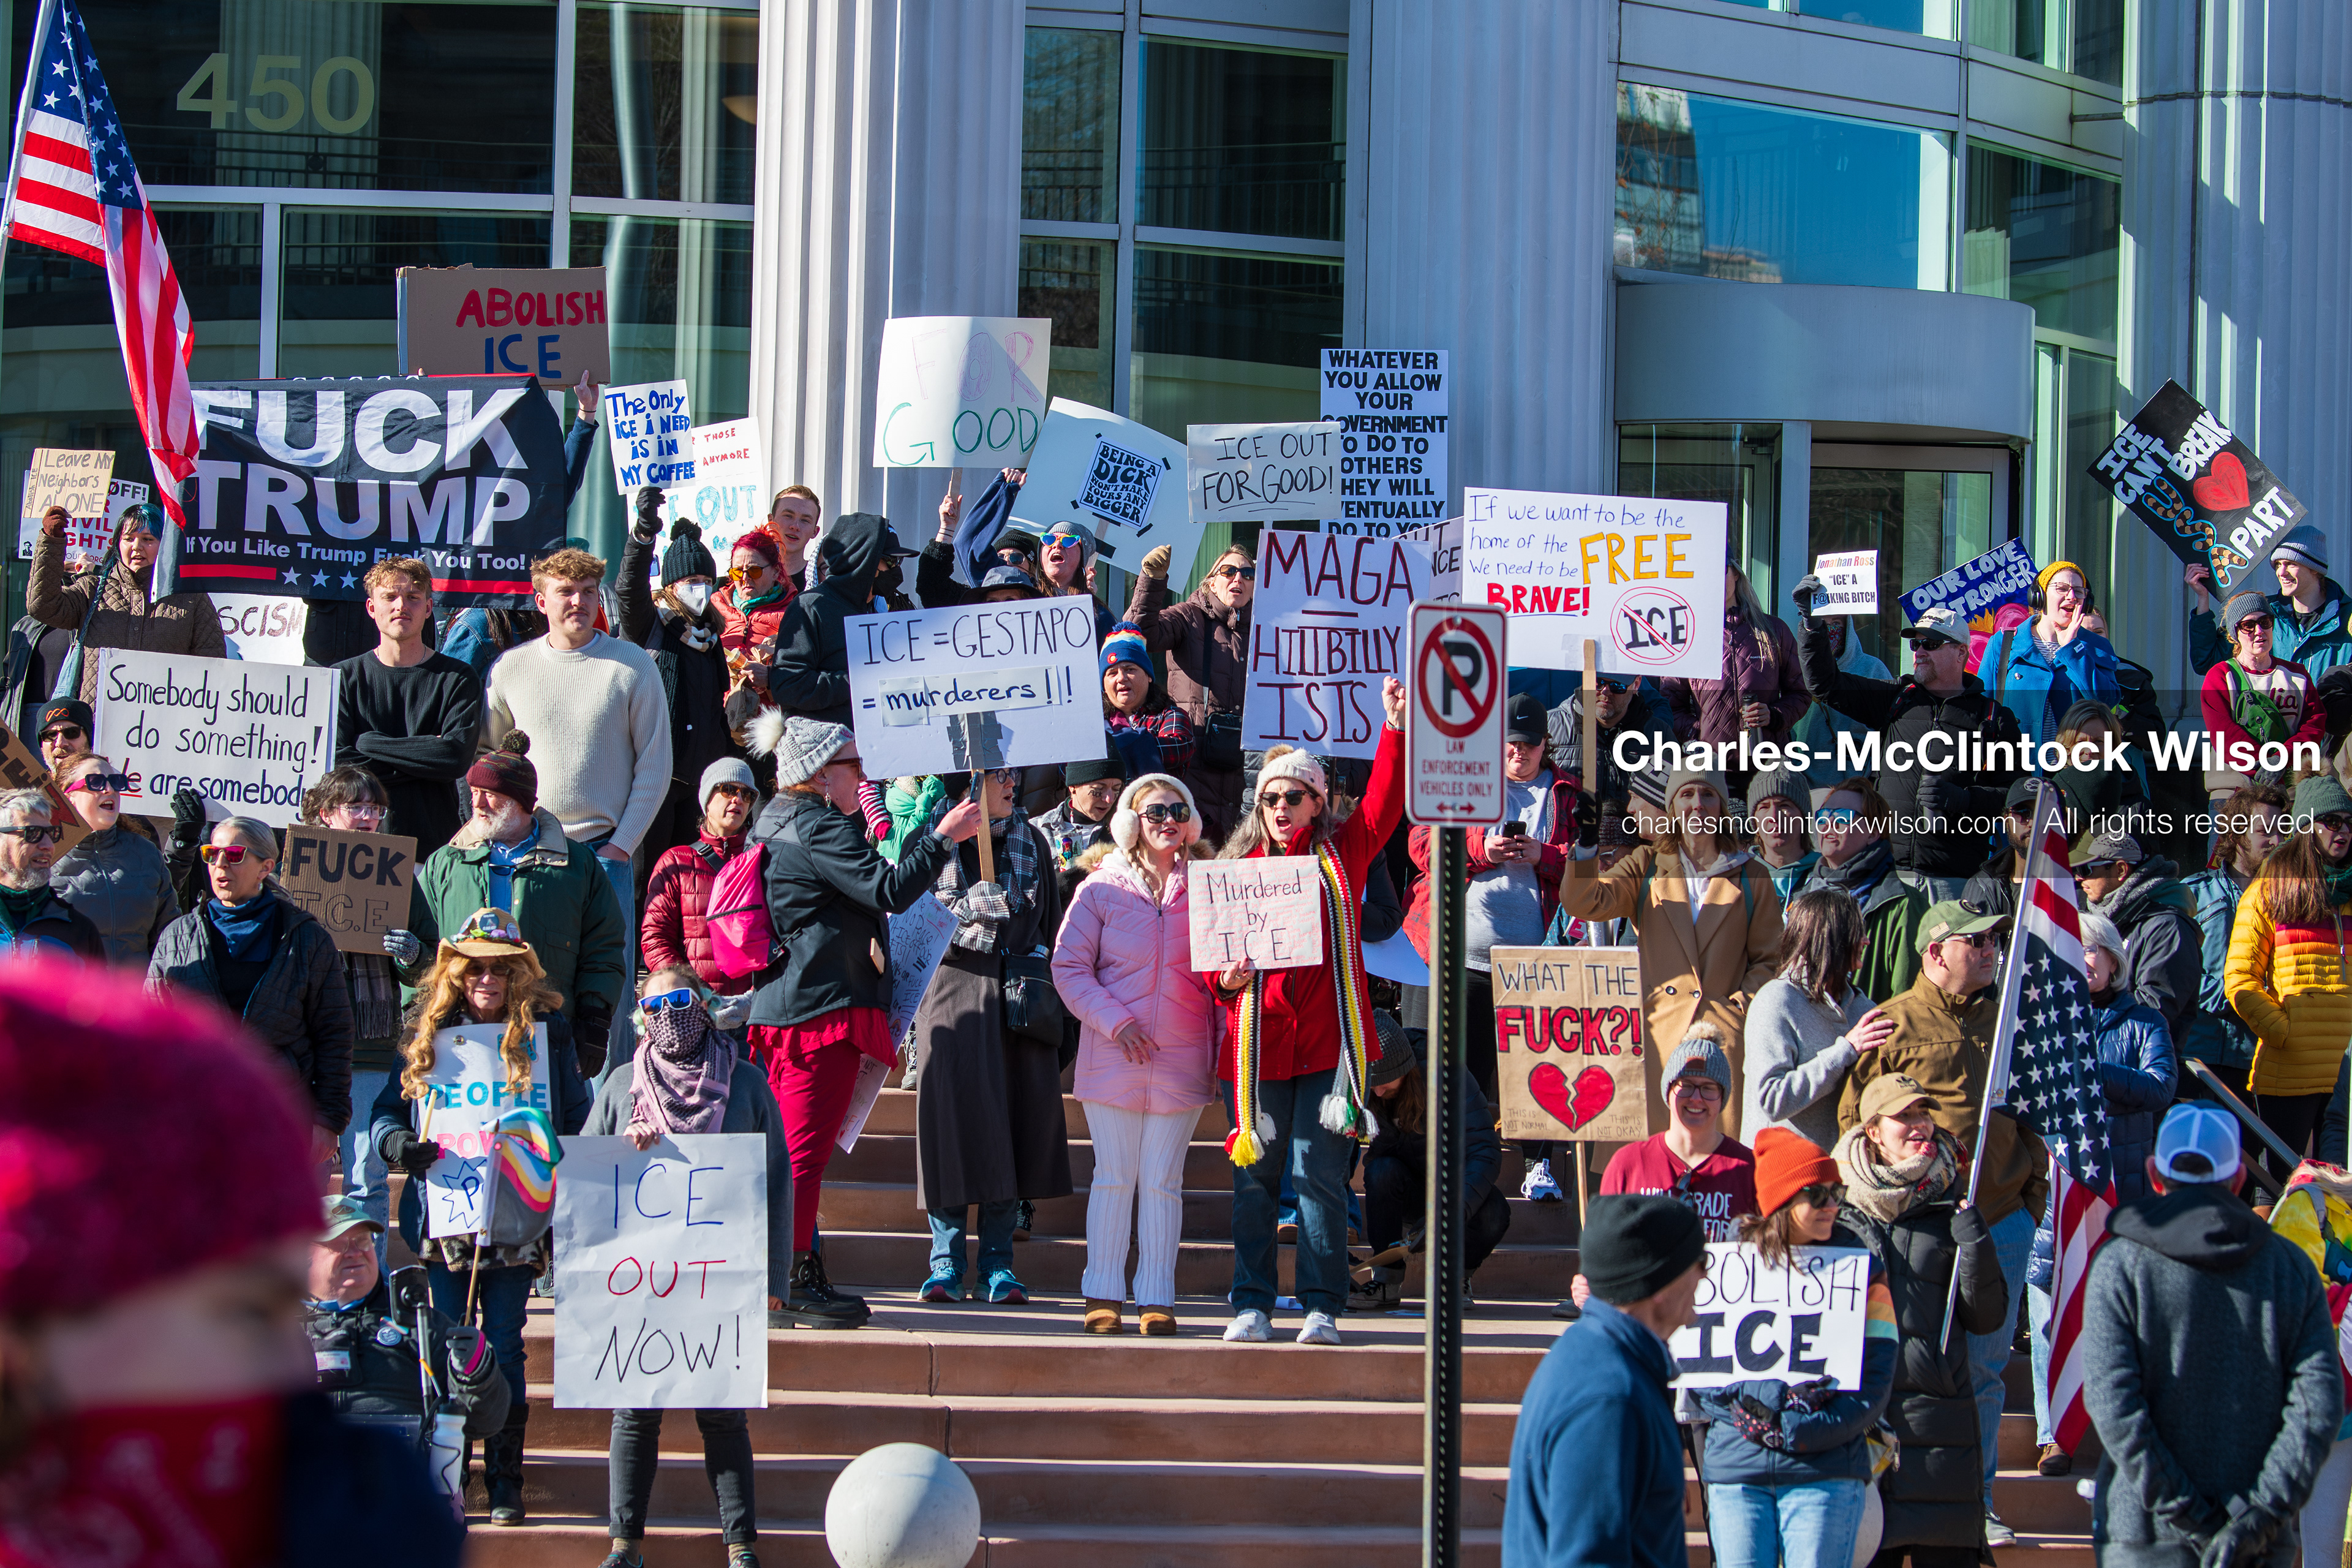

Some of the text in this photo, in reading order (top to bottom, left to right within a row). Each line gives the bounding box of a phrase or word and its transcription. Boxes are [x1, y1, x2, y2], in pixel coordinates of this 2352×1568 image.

[176, 53, 374, 134] 450
[456, 288, 605, 328] ABOLISH
[484, 333, 562, 379] ICE
[912, 328, 1039, 402] FOR
[1329, 350, 1438, 369] WHATEVER
[1324, 371, 1442, 391] YOU ALLOW
[605, 389, 685, 418] The Only
[1355, 392, 1413, 410] YOUR
[192, 387, 530, 473] FUCK
[660, 415, 691, 435] NEED
[704, 428, 736, 442] THOSE
[883, 402, 1039, 466] GOOD
[45, 450, 115, 469] Leave MY
[703, 448, 750, 466] ANYMORE
[1215, 432, 1332, 461] ICE OUT
[1367, 434, 1396, 452] DO
[1402, 437, 1429, 454] TO
[2097, 424, 2153, 480] ICE
[2167, 410, 2233, 481] BREAK
[620, 461, 696, 487] MY COFFEE
[1093, 458, 1152, 494] DICK
[1099, 445, 1156, 477] BEING A
[1340, 456, 1423, 475] OTHERS
[2114, 437, 2172, 505] CAN'T
[39, 473, 99, 494] Neighbors
[1088, 482, 1147, 510] YOURS ANY
[1091, 474, 1149, 502] WON'T MAKE
[1203, 464, 1333, 510] FOR GOOD!
[1341, 478, 1434, 496] HEY WILL
[39, 492, 104, 513] ALONE
[194, 459, 531, 547] TRUMP
[695, 485, 756, 530] OUT
[1083, 491, 1140, 523] BIGGER
[1469, 494, 1498, 522] If
[1546, 503, 1592, 522] want
[1594, 503, 1615, 523] to
[1621, 504, 1646, 526] be
[1654, 508, 1686, 528] the
[71, 518, 113, 532] IVIL
[1329, 522, 1357, 535] DO
[1366, 522, 1391, 538] TO
[2142, 476, 2249, 587] USA
[186, 538, 195, 553] If
[198, 537, 236, 554] You
[244, 538, 290, 557] Like
[297, 541, 366, 566] Trump
[431, 551, 471, 570] You
[477, 552, 525, 570] Too!
[1264, 531, 1414, 607] MAGA
[1470, 527, 1509, 551] home
[1517, 533, 1536, 549] of
[1544, 534, 1568, 554] the
[1579, 532, 1695, 584] FREE
[1497, 560, 1532, 576] need
[1536, 560, 1553, 576] to
[1560, 562, 1578, 578] be
[1817, 556, 1874, 570] Jonathan Ross
[1852, 573, 1858, 585] A
[1912, 541, 2026, 611] OUR LOVE
[1935, 559, 2037, 617] TRONGER
[1487, 582, 1591, 617] BRAVE!
[1851, 592, 1875, 603] BITCH
[218, 603, 304, 638] SCISM
[858, 619, 925, 665] ICE
[952, 607, 1092, 658] GESTAPO
[1624, 605, 1688, 650] ICE
[1253, 624, 1401, 677] HILLBILLY
[107, 663, 308, 725] Somebody should
[2269, 687, 2298, 709] lia
[1257, 680, 1372, 744] ISIS
[126, 710, 323, 774] do something!
[1446, 739, 1466, 755] LAW
[1422, 759, 1491, 777] ENFORCEMENT
[150, 773, 192, 796] are
[199, 769, 306, 823] somebod
[1419, 780, 1493, 797] VEHICLES ONLY
[290, 837, 407, 887] FUCK
[1206, 869, 1302, 904] Murdered
[1245, 902, 1268, 932] by
[1218, 928, 1291, 963] ICE
[1498, 963, 1638, 996] WHAT THE
[1496, 1005, 1643, 1057] FUCK?!
[425, 1081, 547, 1110] PEOPLE
[1504, 1121, 1550, 1131] NOT NORMAL
[1507, 1109, 1536, 1118] THIS IS
[1610, 1115, 1642, 1125] THIS IS
[1597, 1127, 1643, 1138] NOT OKAY
[614, 1163, 724, 1230] ICE
[1690, 1191, 1733, 1219] RADE
[608, 1256, 727, 1300] OUT
[1694, 1250, 1861, 1311] BOLISH
[595, 1314, 740, 1383] NOW!
[1677, 1310, 1828, 1376] ICE
